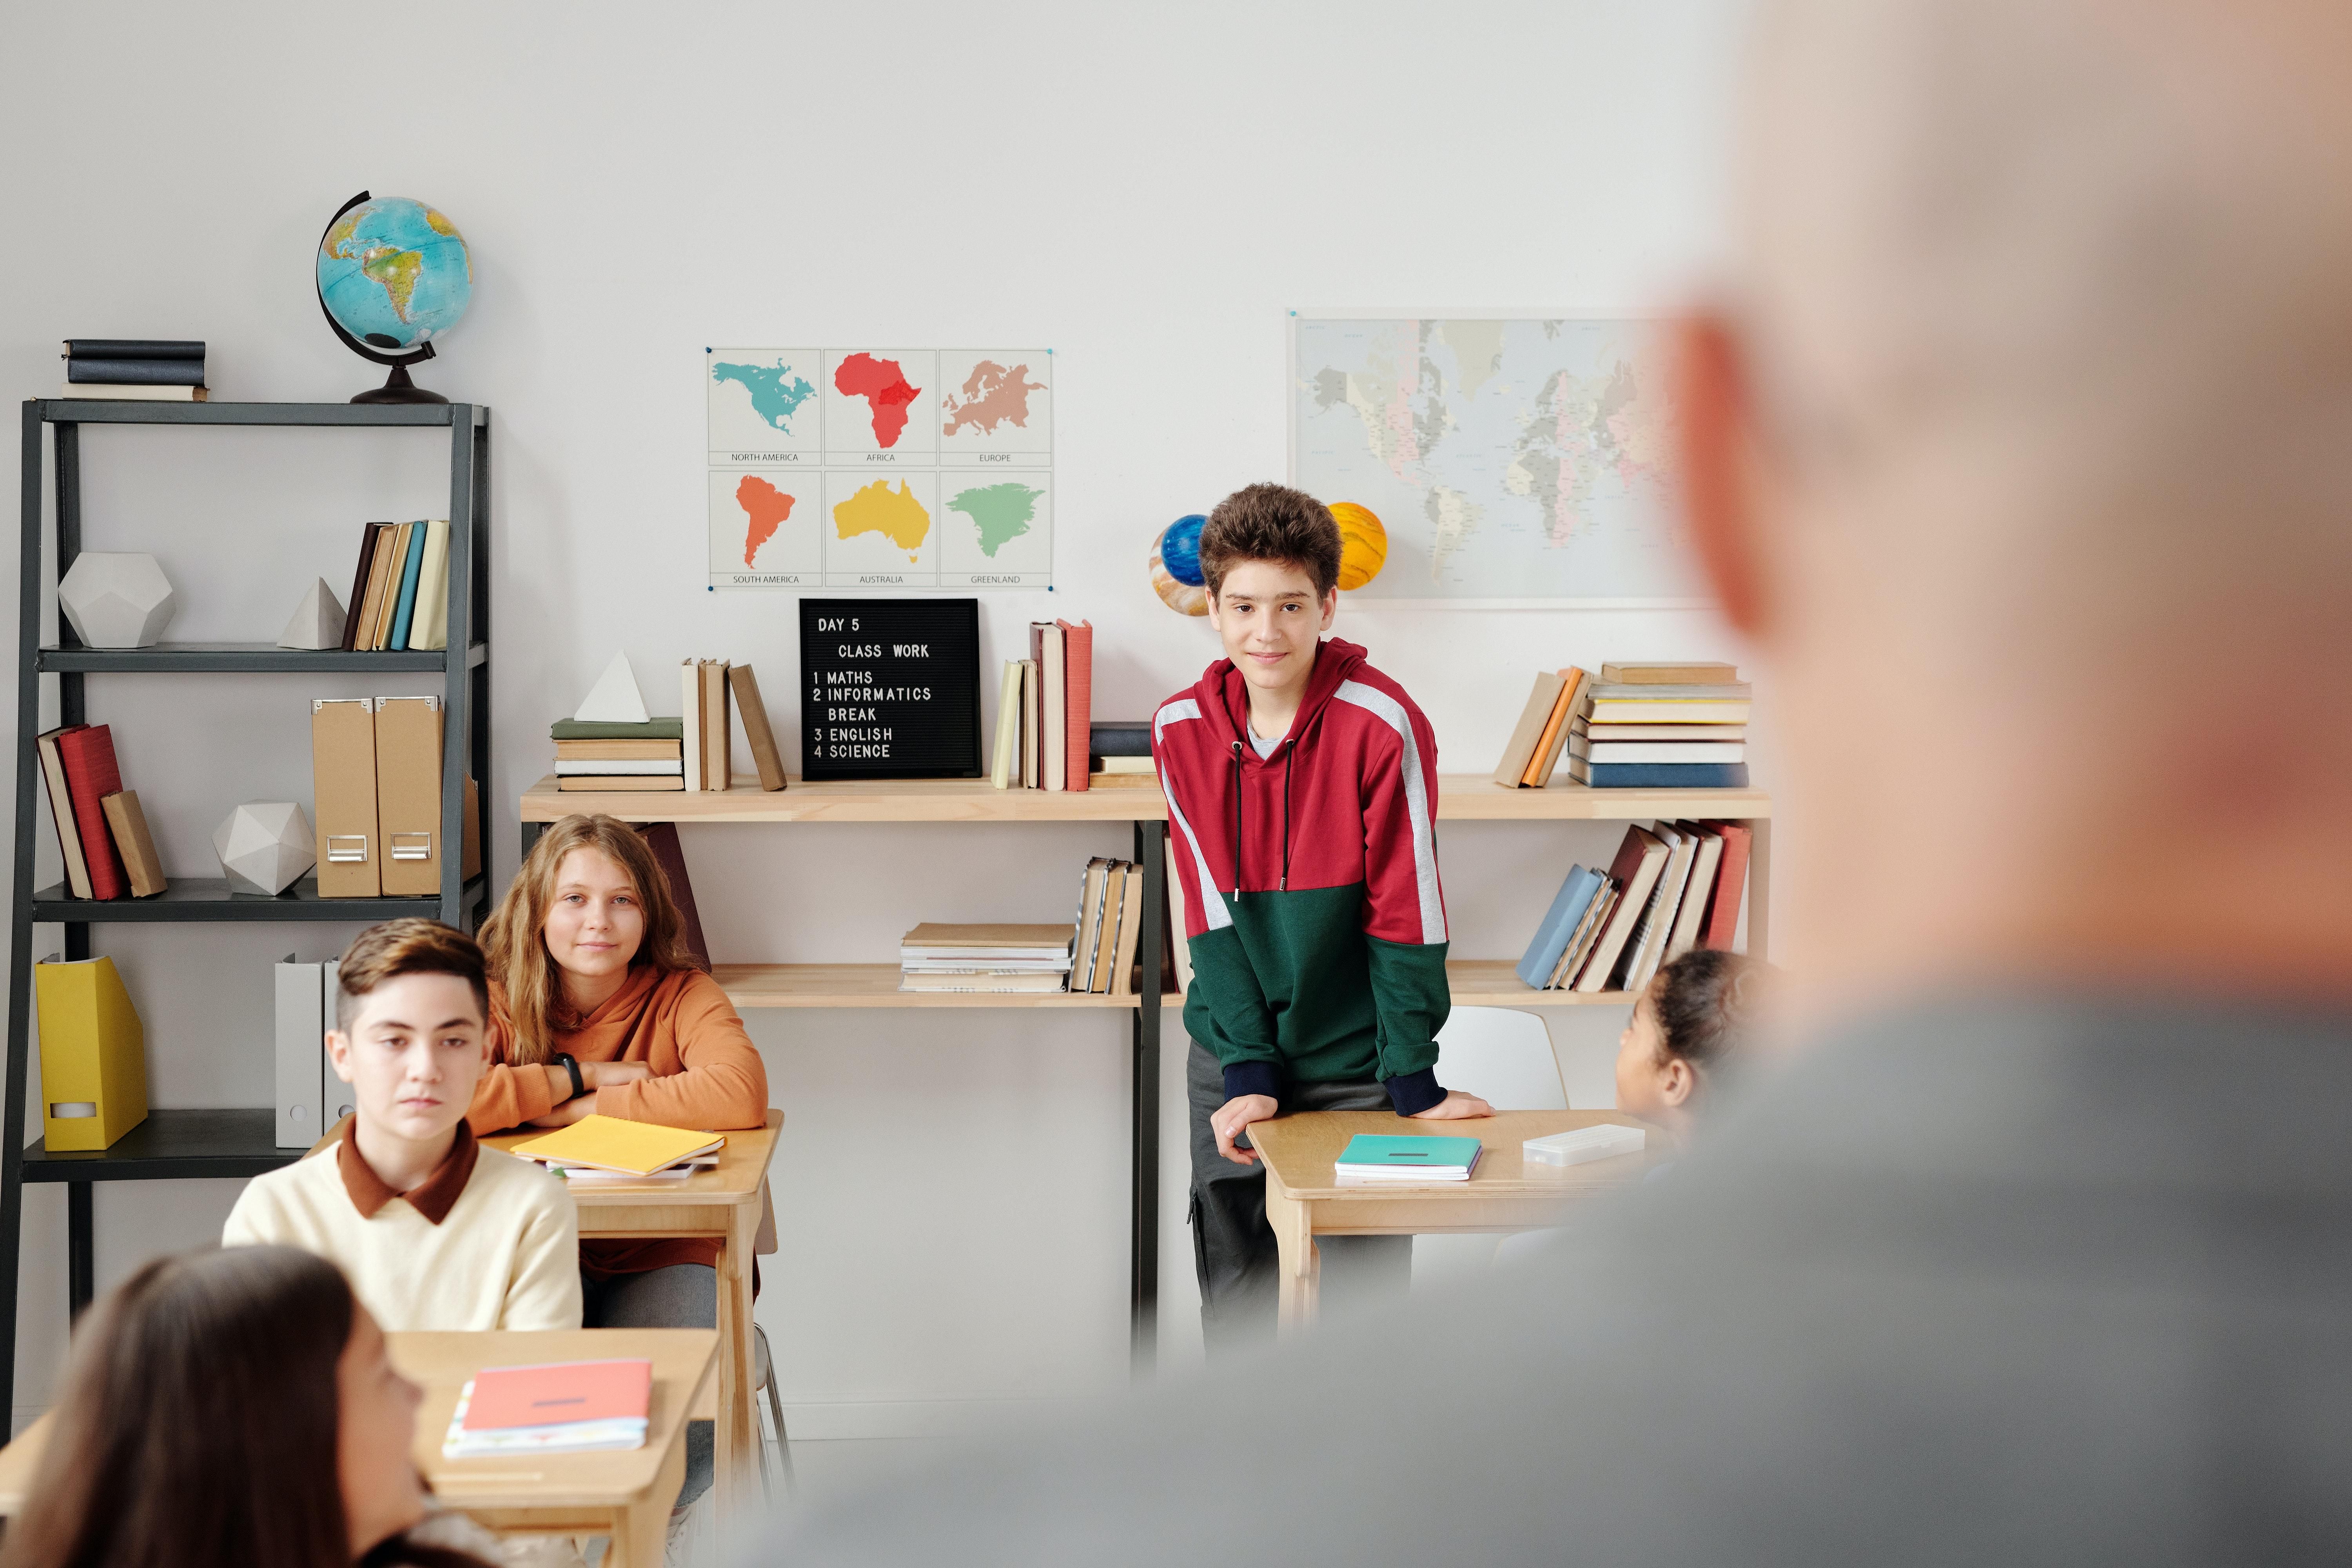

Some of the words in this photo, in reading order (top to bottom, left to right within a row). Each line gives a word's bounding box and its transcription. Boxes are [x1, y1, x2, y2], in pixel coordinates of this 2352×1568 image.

[818, 619, 844, 631] DAY
[852, 619, 859, 631] 5
[839, 645, 881, 657] CLASS
[893, 644, 929, 657] WORK
[814, 672, 817, 684] 1
[828, 671, 872, 684] MATHS
[813, 688, 820, 701] 2
[828, 688, 931, 701] INFORMATICS
[829, 708, 876, 721] BREAK
[815, 729, 822, 741] 3
[831, 728, 891, 741] ENGLISH
[815, 746, 821, 757] 4
[830, 745, 889, 758] SCIENCE
